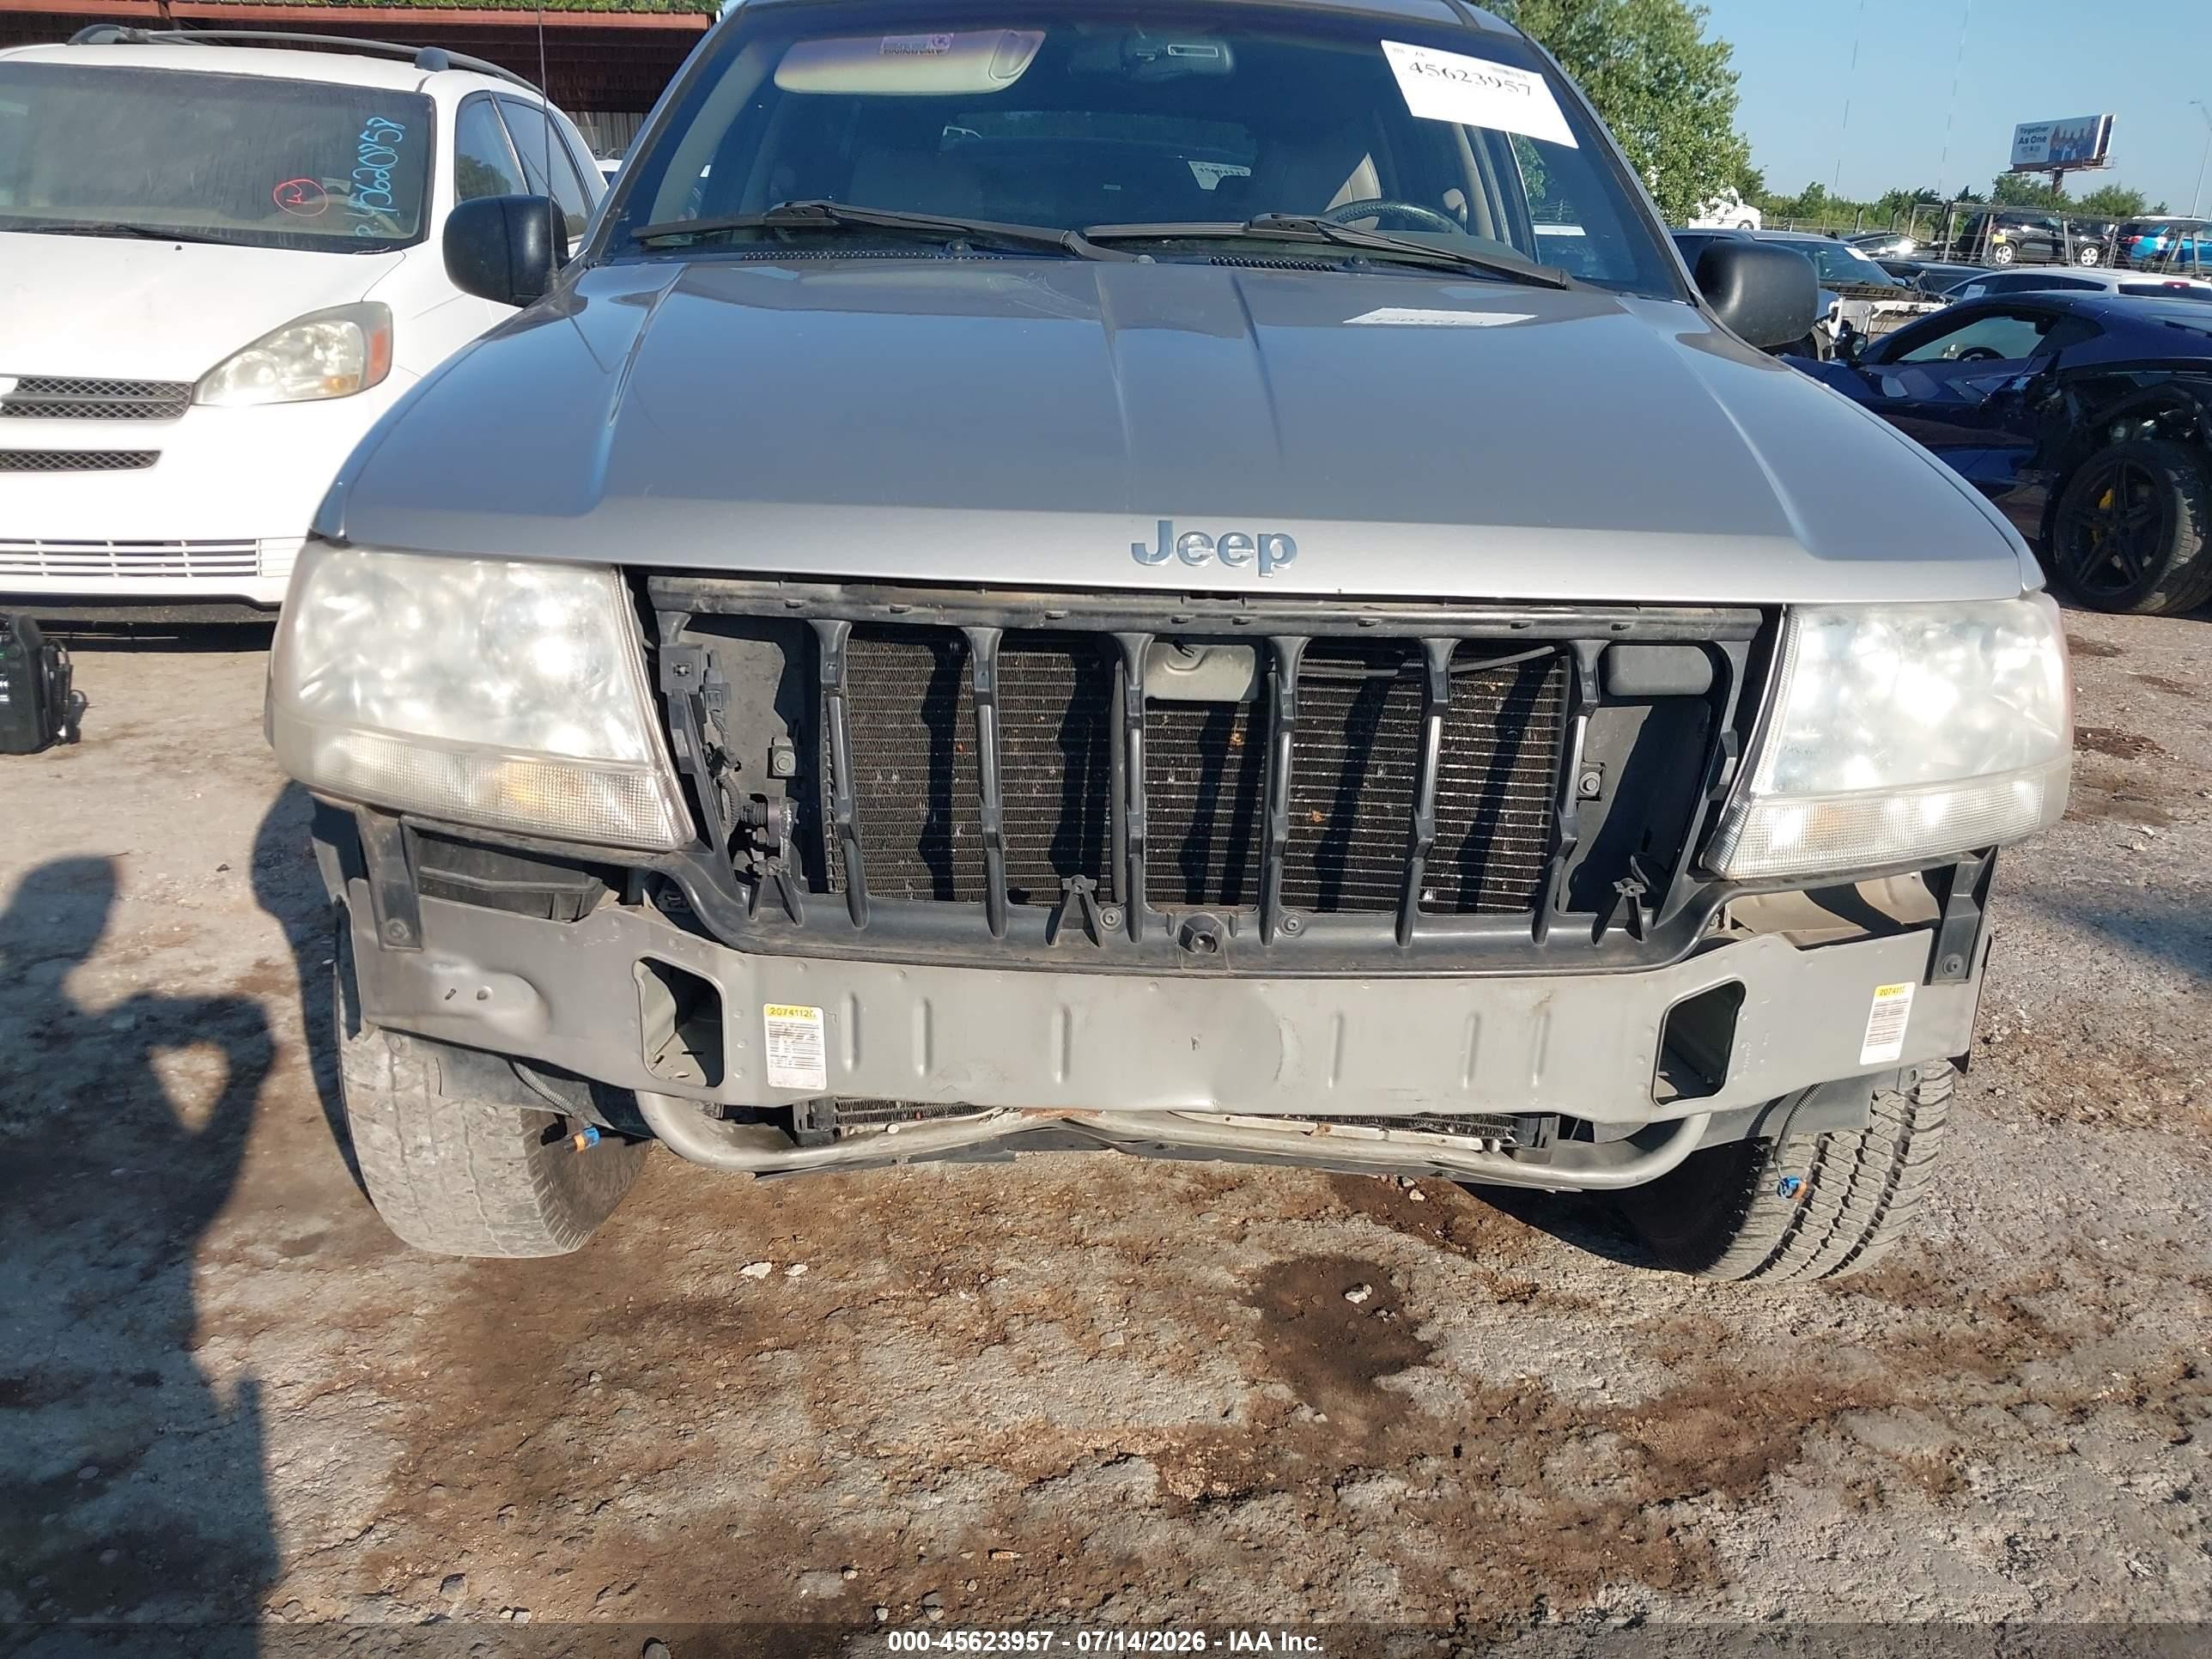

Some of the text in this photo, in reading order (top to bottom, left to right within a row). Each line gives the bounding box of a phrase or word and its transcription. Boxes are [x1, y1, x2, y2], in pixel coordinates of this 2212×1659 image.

[1409, 62, 1531, 96] 45623957
[2020, 125, 2049, 136] Together
[2031, 136, 2048, 144] One
[1130, 520, 1297, 578] Jeep
